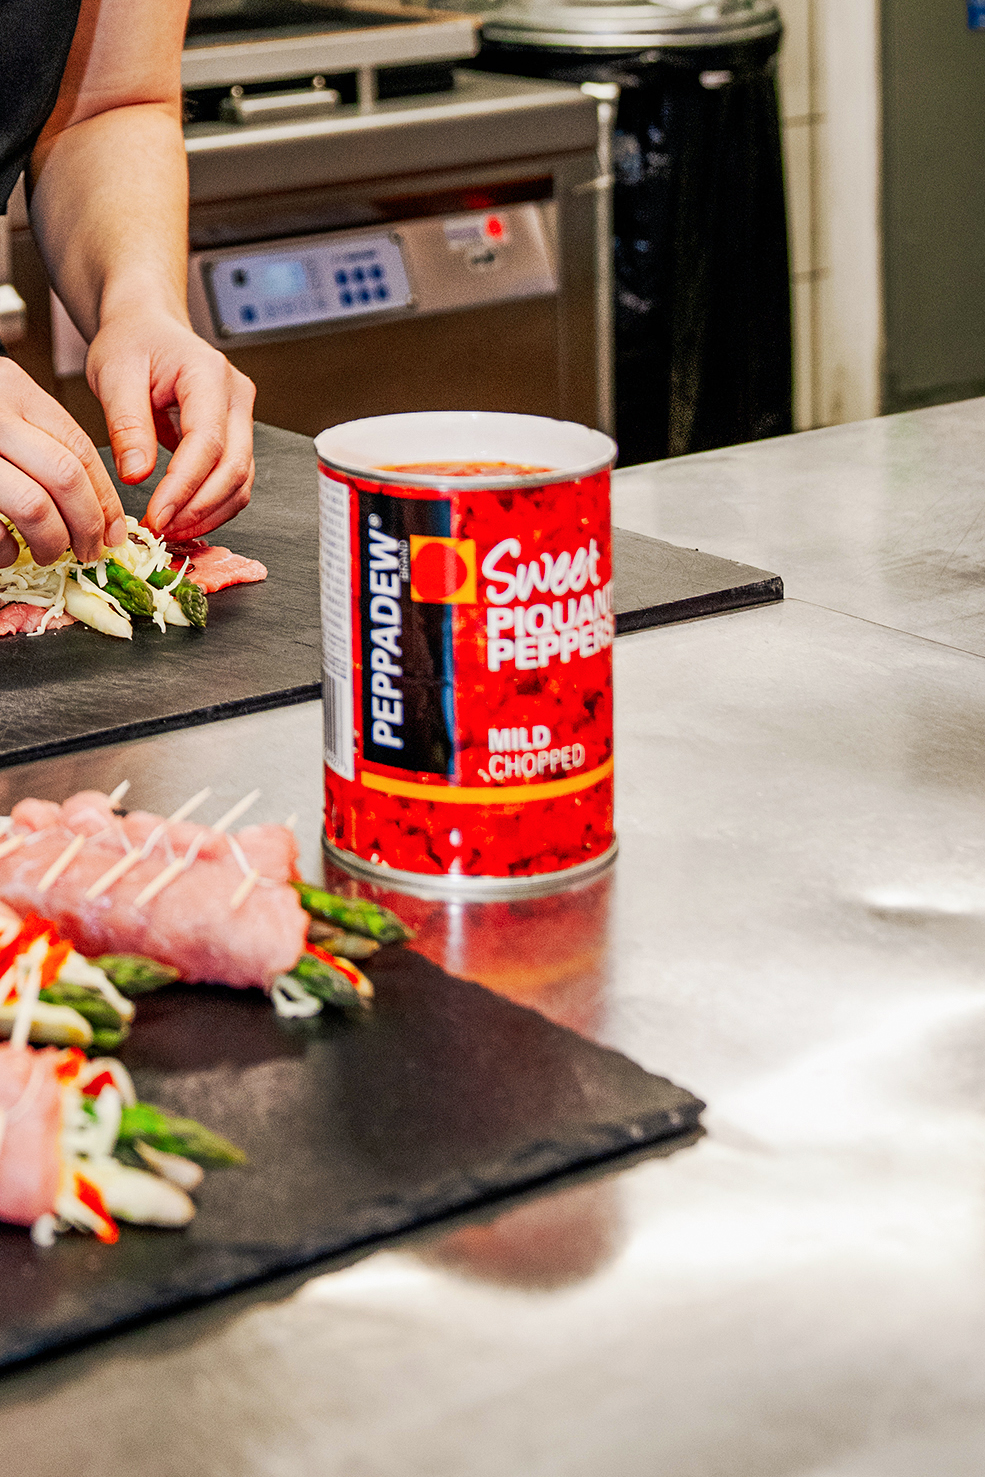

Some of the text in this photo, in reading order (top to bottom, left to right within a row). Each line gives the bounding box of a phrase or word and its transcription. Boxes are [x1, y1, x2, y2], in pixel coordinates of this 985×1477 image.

[398, 539, 410, 582] BRAND
[481, 538, 601, 605] Sweet
[488, 725, 551, 753] MILD
[488, 743, 586, 781] CHOPPED
